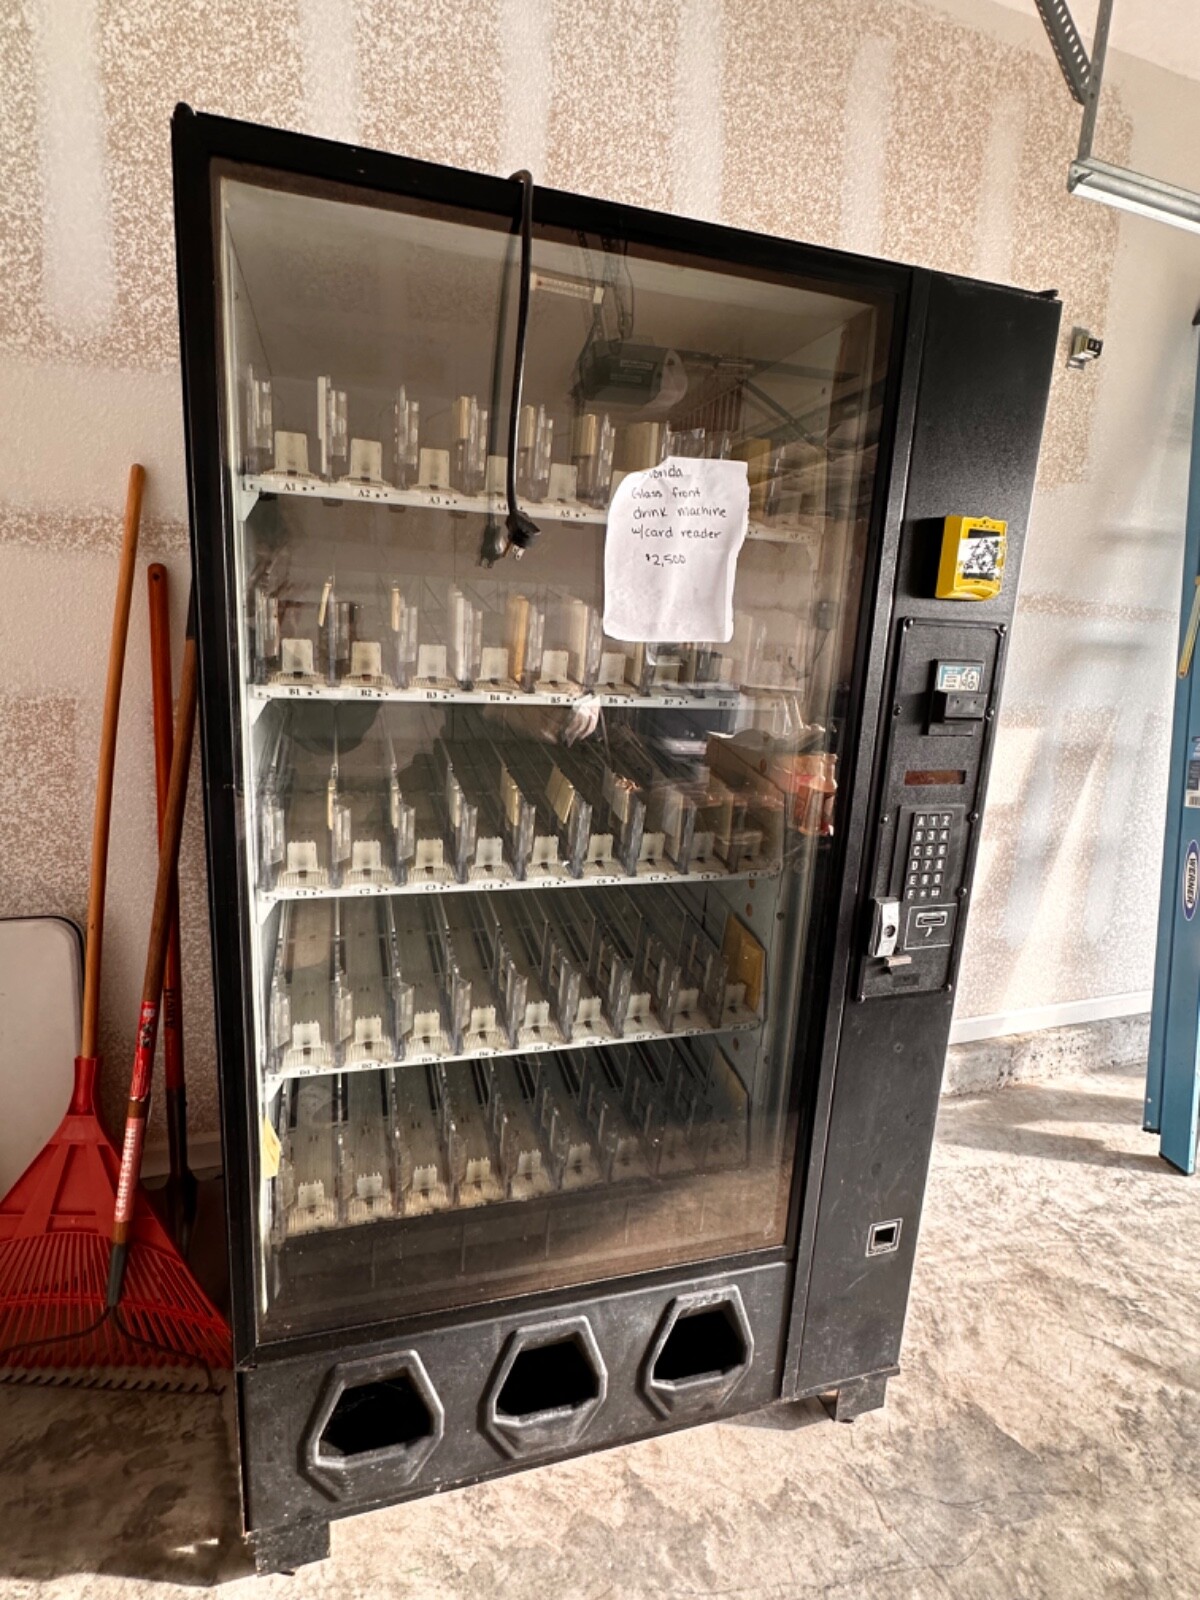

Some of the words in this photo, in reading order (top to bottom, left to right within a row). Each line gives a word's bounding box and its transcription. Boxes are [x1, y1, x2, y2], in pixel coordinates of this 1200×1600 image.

[283, 483, 296, 491] A1
[632, 487, 662, 499] Glass
[672, 487, 700, 499] front
[358, 490, 370, 498] A2
[428, 496, 441, 505] A3
[633, 507, 668, 519] drink
[678, 505, 727, 518] machine
[631, 523, 673, 540] w/card
[680, 528, 722, 539] reader
[361, 689, 372, 697] B2
[1186, 858, 1197, 904] WERNER
[115, 1127, 136, 1217] CRAFTSMAN
